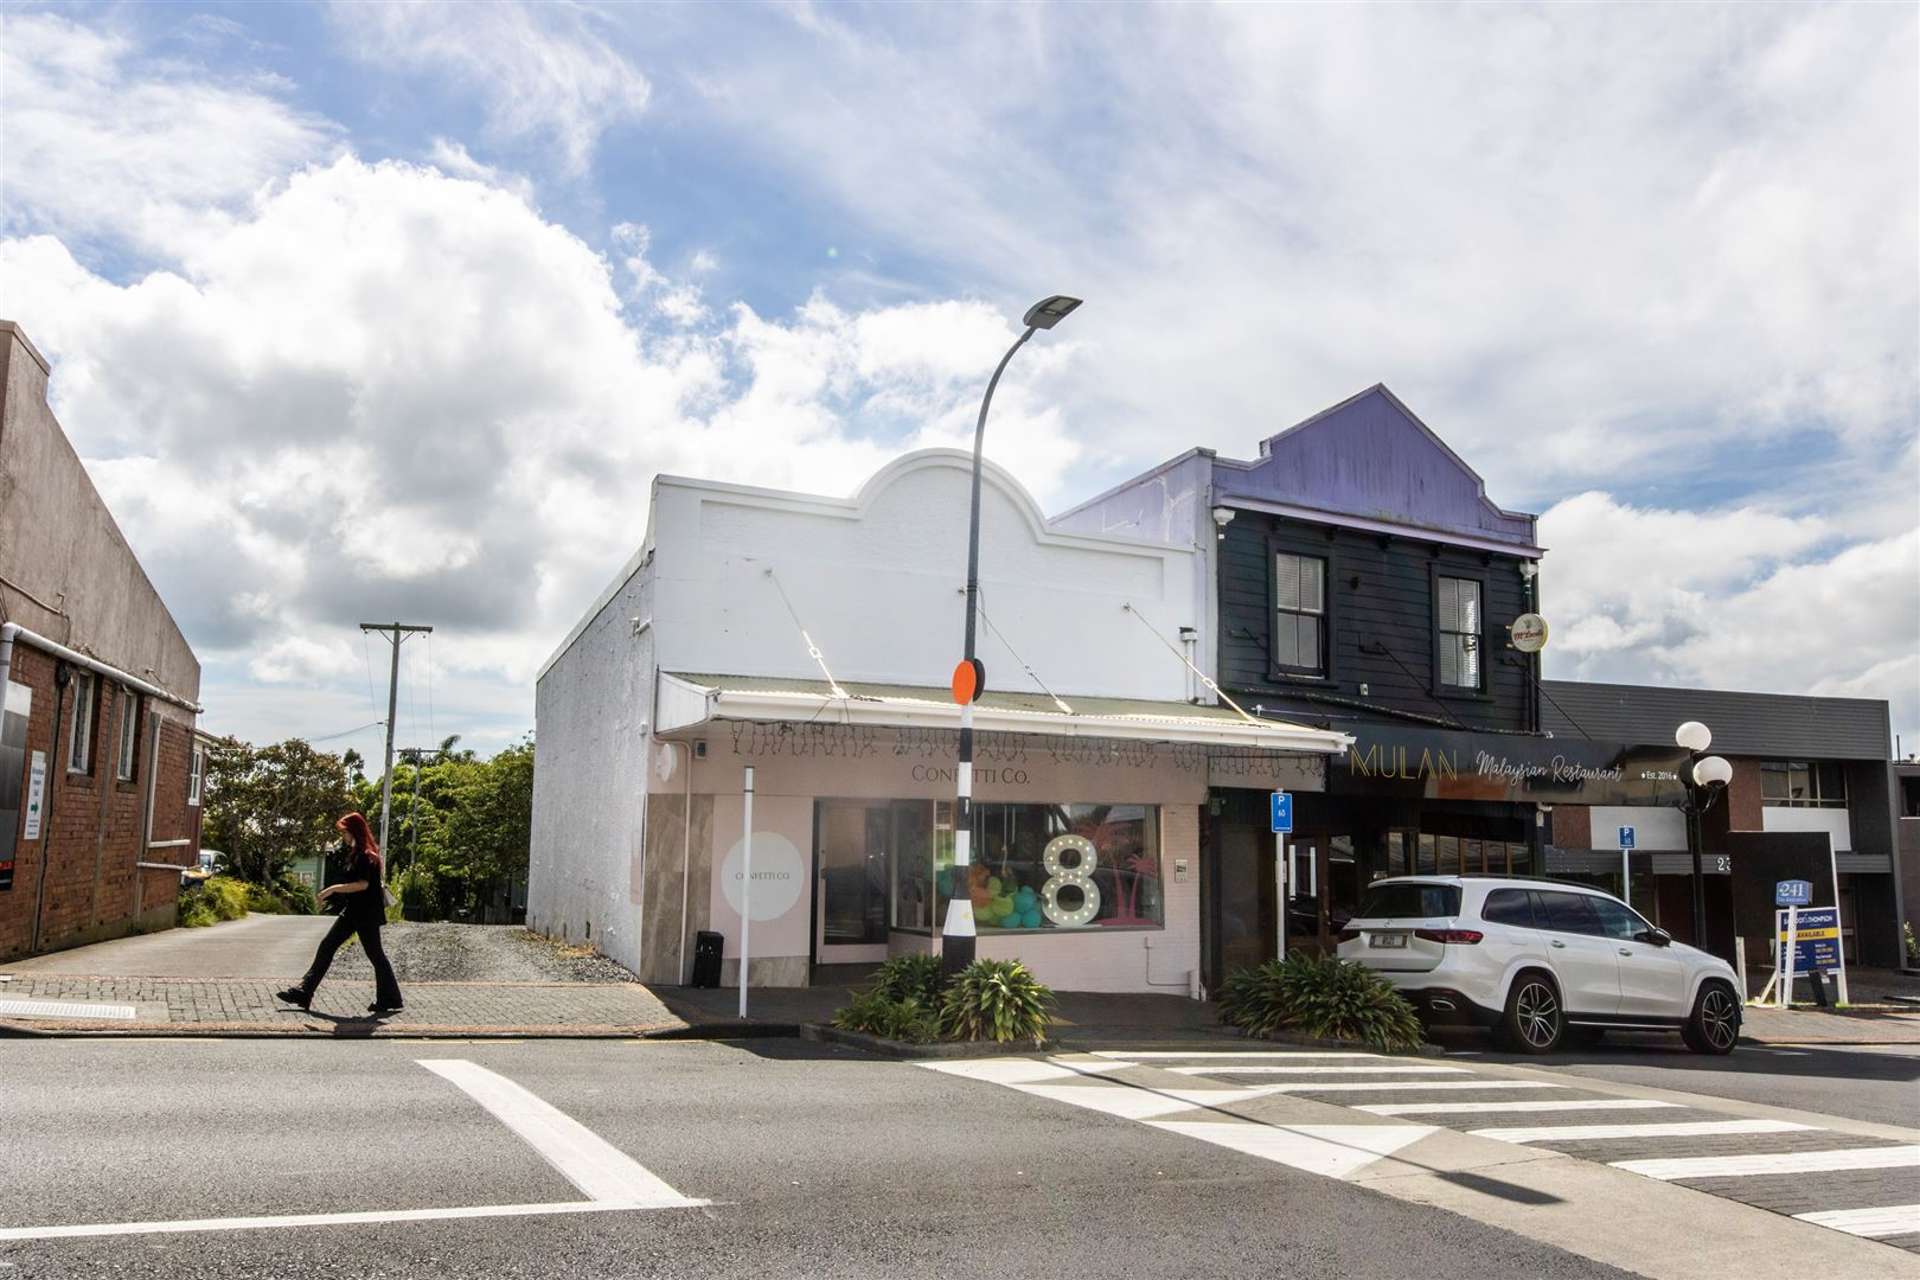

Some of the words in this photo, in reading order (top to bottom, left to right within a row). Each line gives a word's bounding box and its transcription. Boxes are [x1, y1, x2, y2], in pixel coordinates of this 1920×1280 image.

[912, 764, 996, 783] CONTTI
[1351, 743, 1457, 781] MULAN
[1475, 750, 1548, 785] Malaysian
[1551, 754, 1622, 784] Restaurant
[1278, 795, 1286, 806] P
[735, 871, 776, 881] CNFETTI
[1041, 834, 1101, 927] 8
